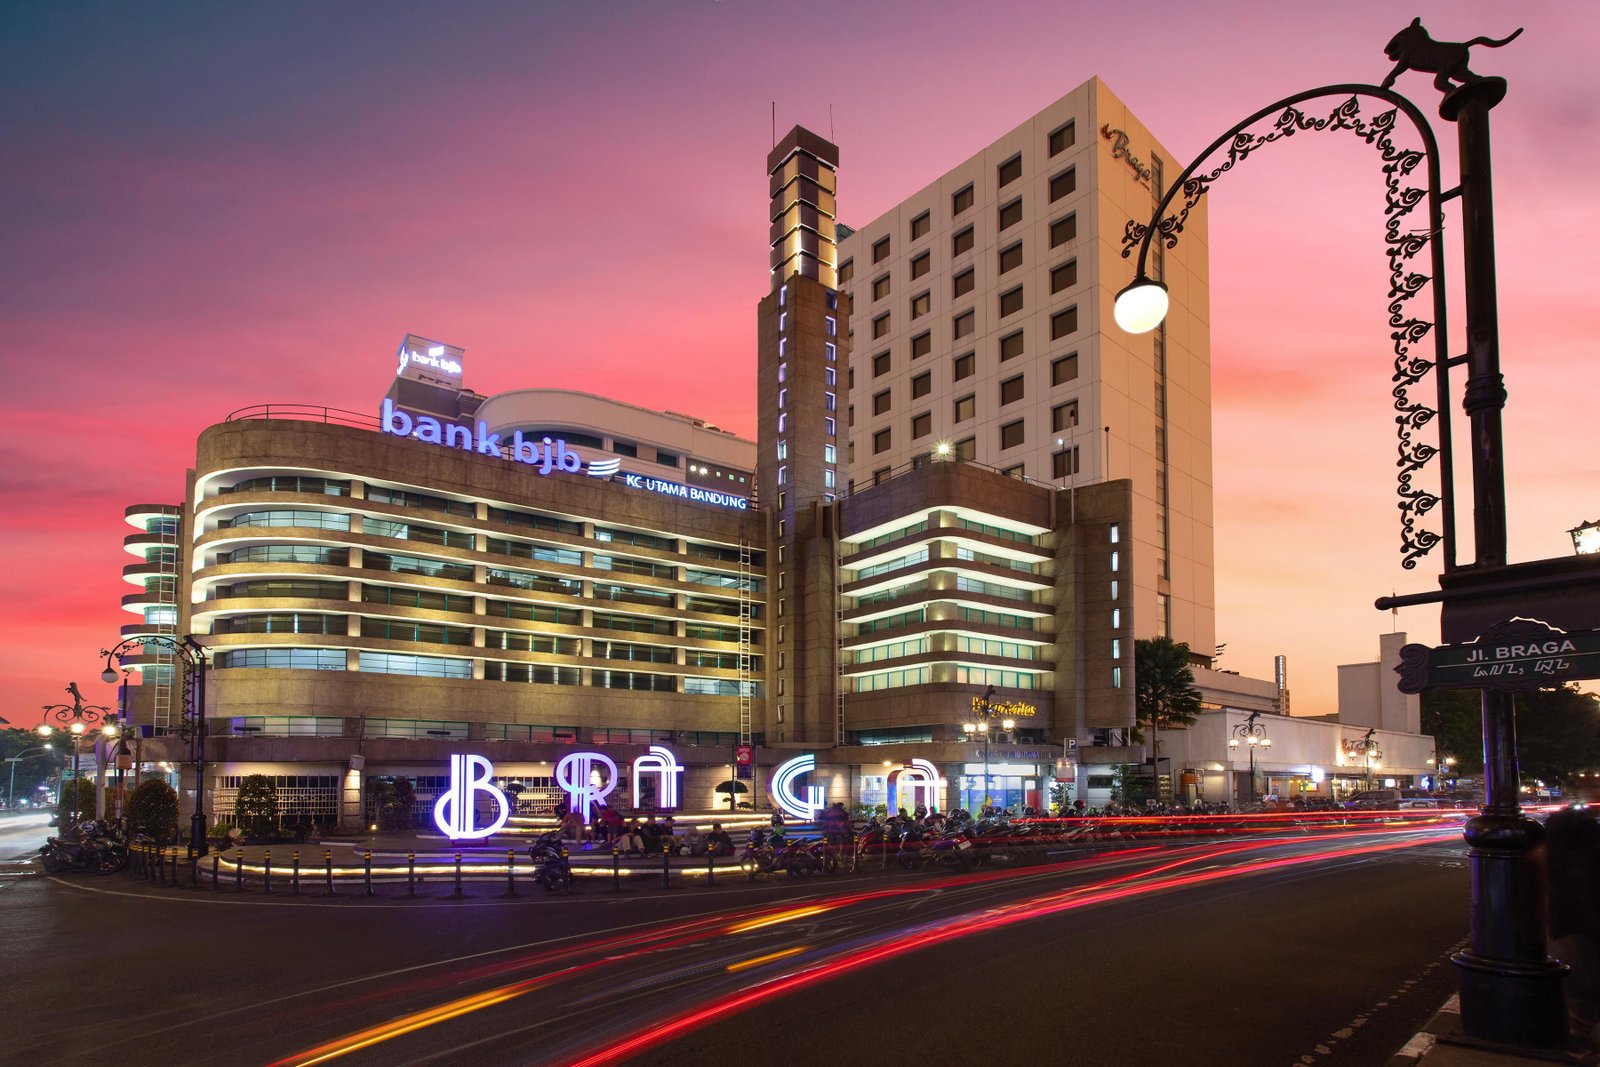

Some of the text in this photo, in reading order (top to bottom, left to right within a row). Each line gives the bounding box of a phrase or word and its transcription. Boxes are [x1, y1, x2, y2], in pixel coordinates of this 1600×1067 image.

[412, 351, 440, 367] bank
[381, 398, 582, 475] bank bjb
[626, 474, 747, 510] KC UTAMA BANDUNG
[1466, 639, 1577, 662] Jl. BRAGA
[1069, 739, 1076, 749] P
